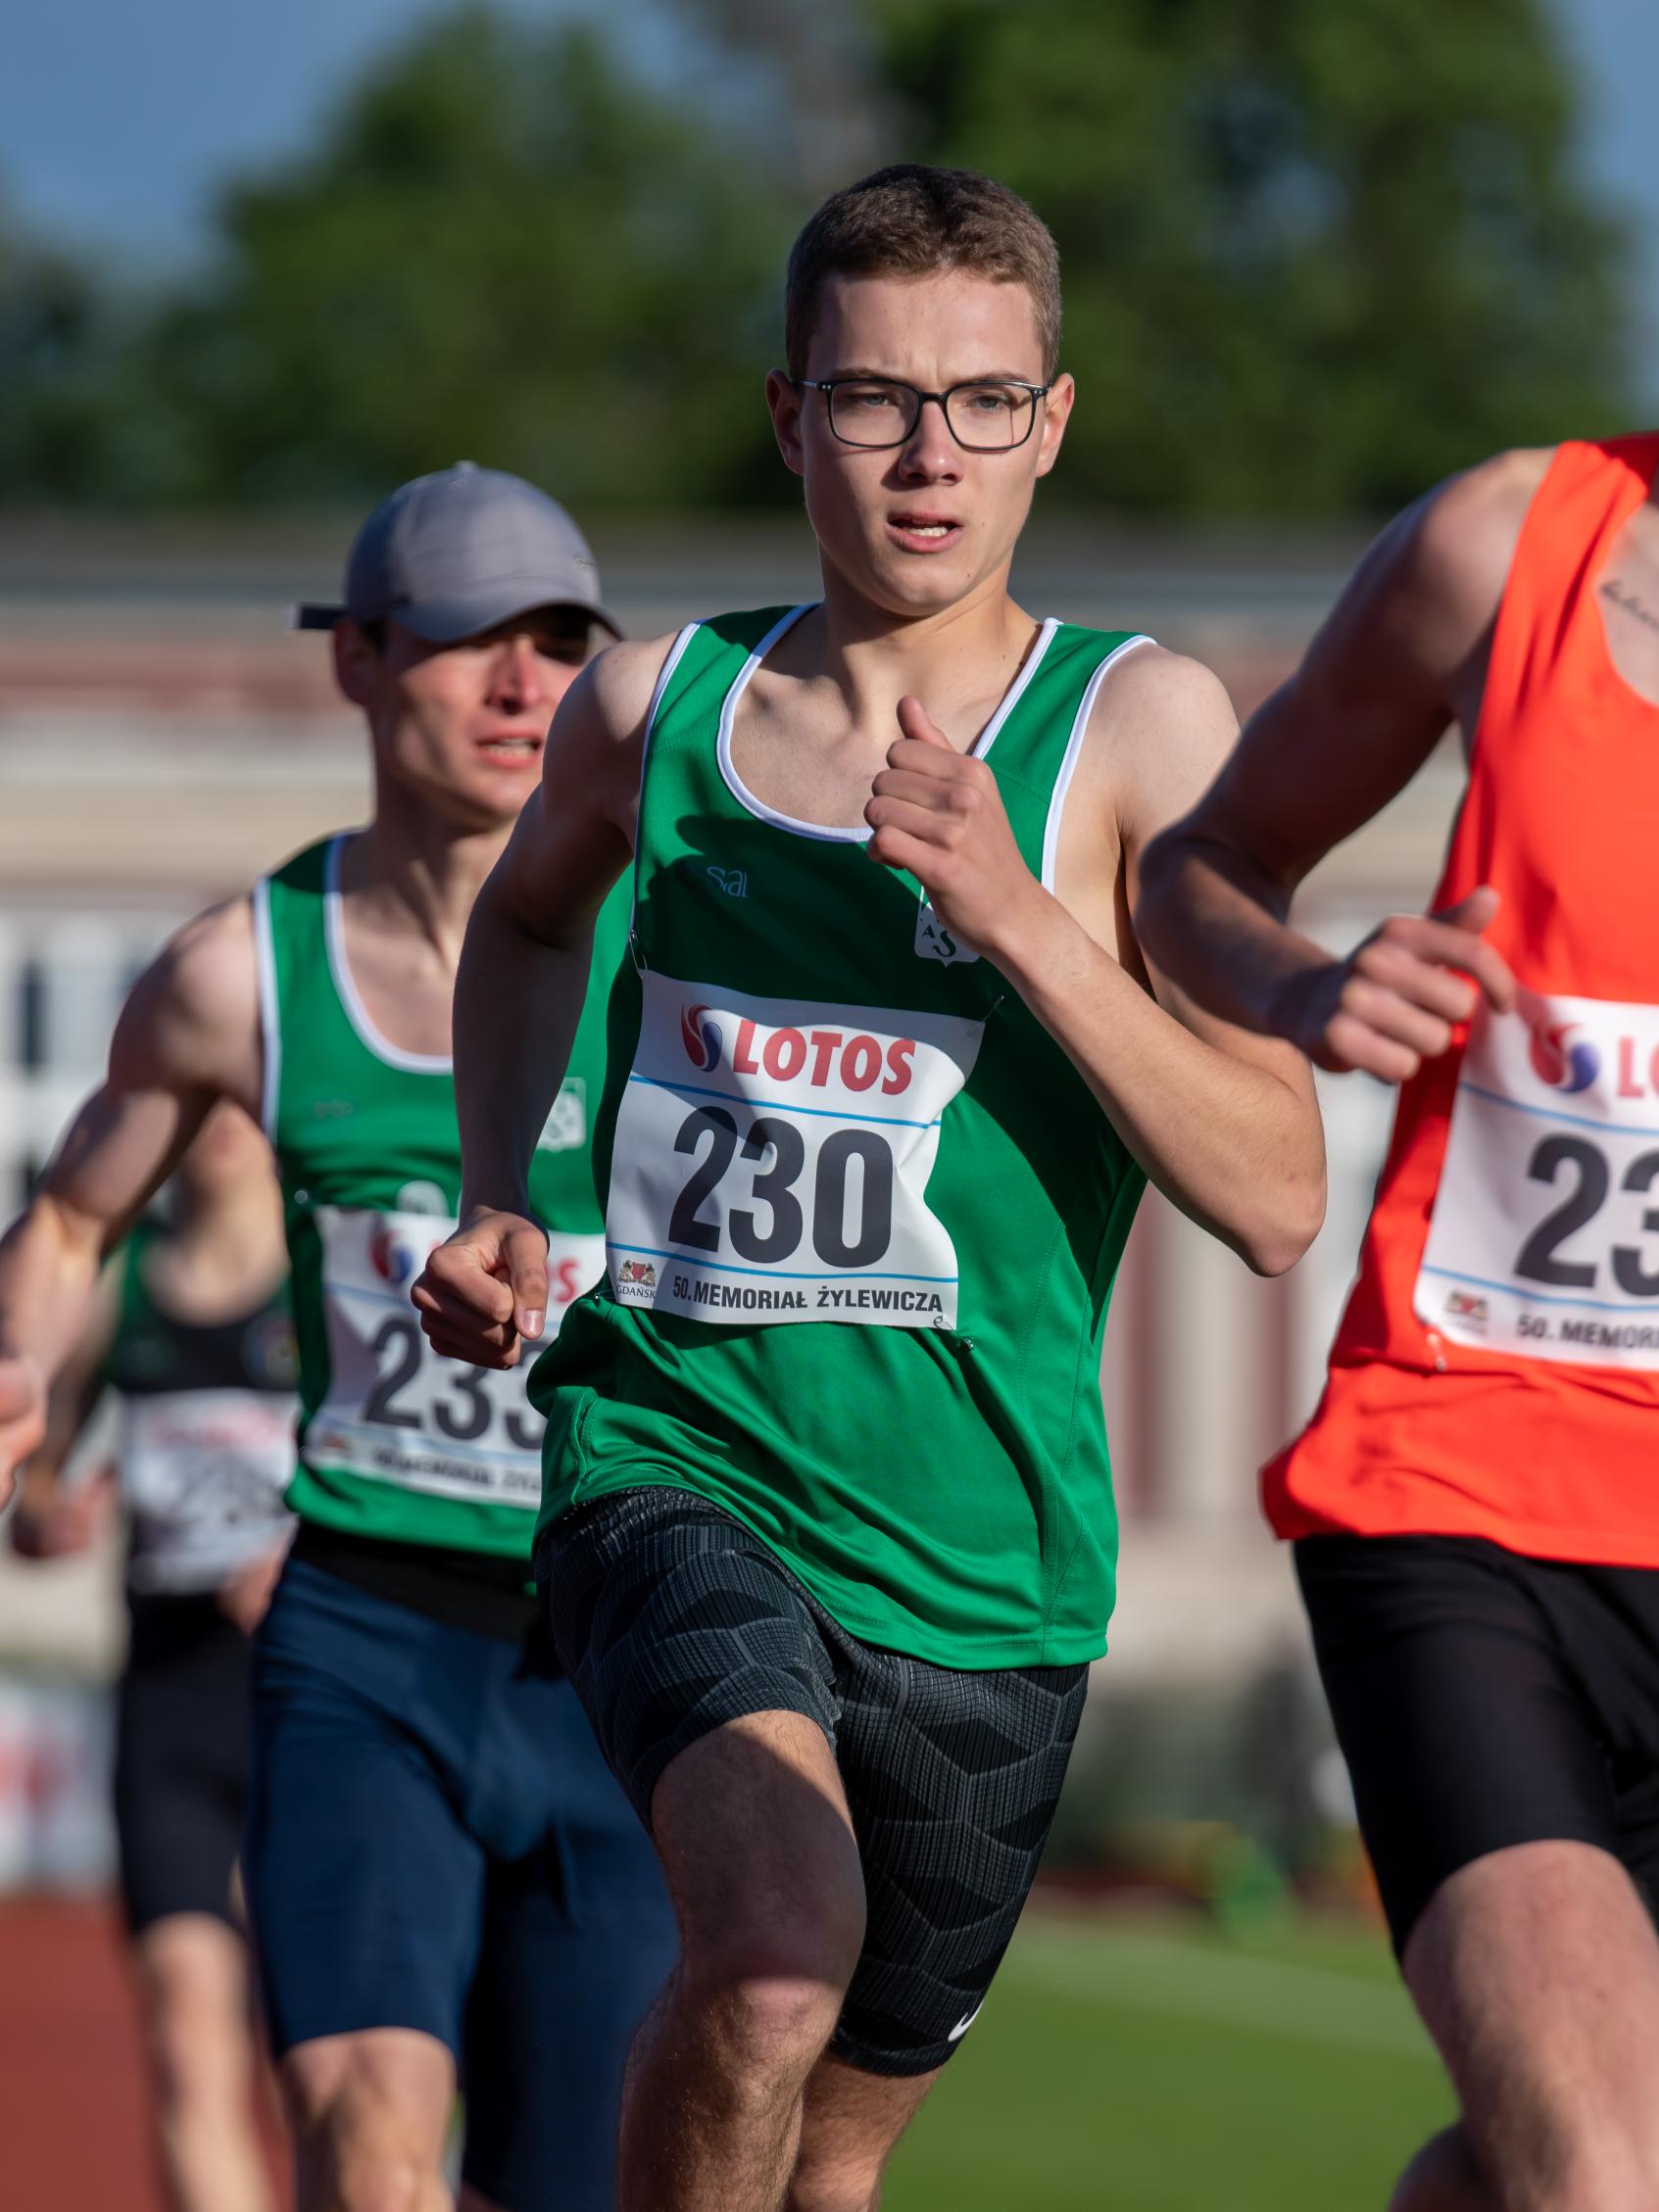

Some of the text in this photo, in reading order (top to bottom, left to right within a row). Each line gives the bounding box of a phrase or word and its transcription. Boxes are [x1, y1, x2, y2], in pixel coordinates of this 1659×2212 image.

[733, 1019, 915, 1096] LOTOS
[667, 1105, 893, 1269] 230
[816, 1285, 943, 1312] ŻYLEWICZA
